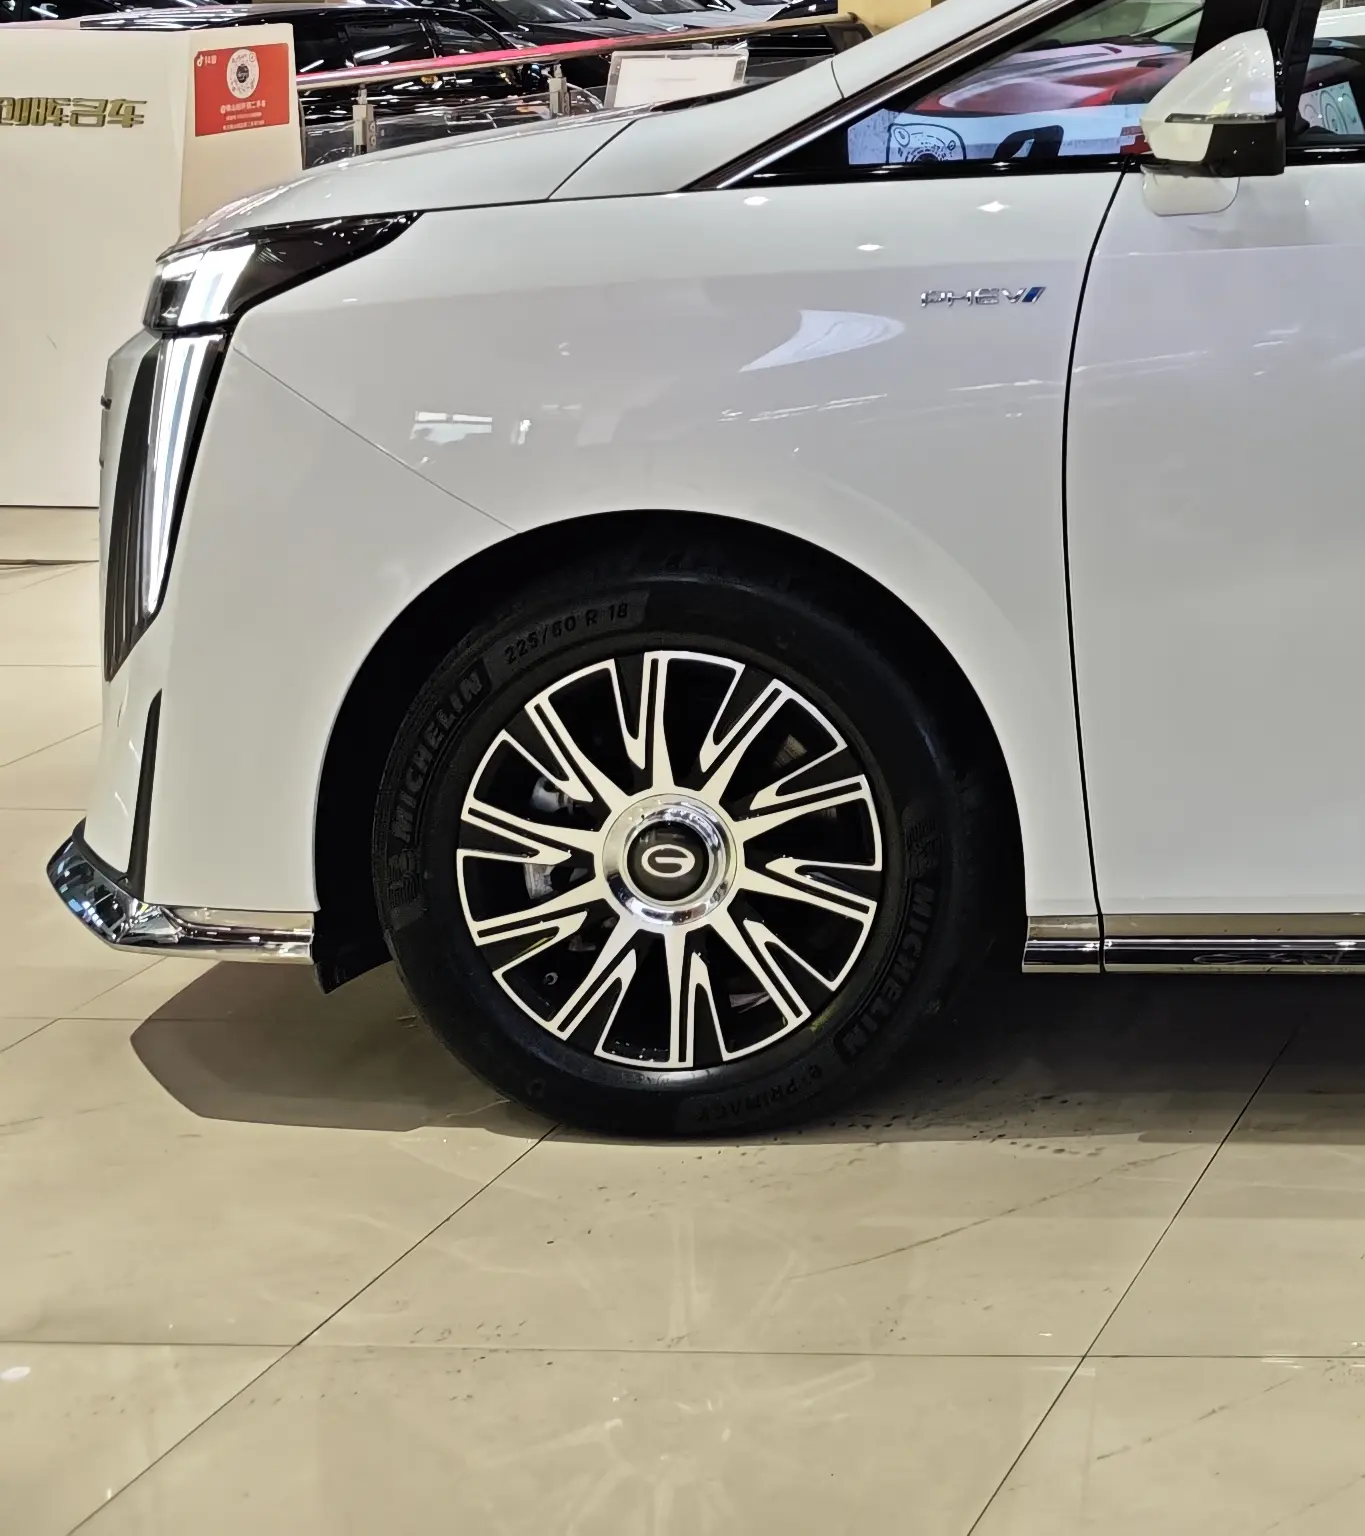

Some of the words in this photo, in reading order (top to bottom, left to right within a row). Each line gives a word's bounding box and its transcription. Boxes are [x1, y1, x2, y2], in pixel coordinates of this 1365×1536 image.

[920, 288, 1026, 307] PHEV
[608, 602, 629, 622] 18
[391, 670, 485, 843] MICHELIN
[842, 884, 936, 1056] MICHELIN
